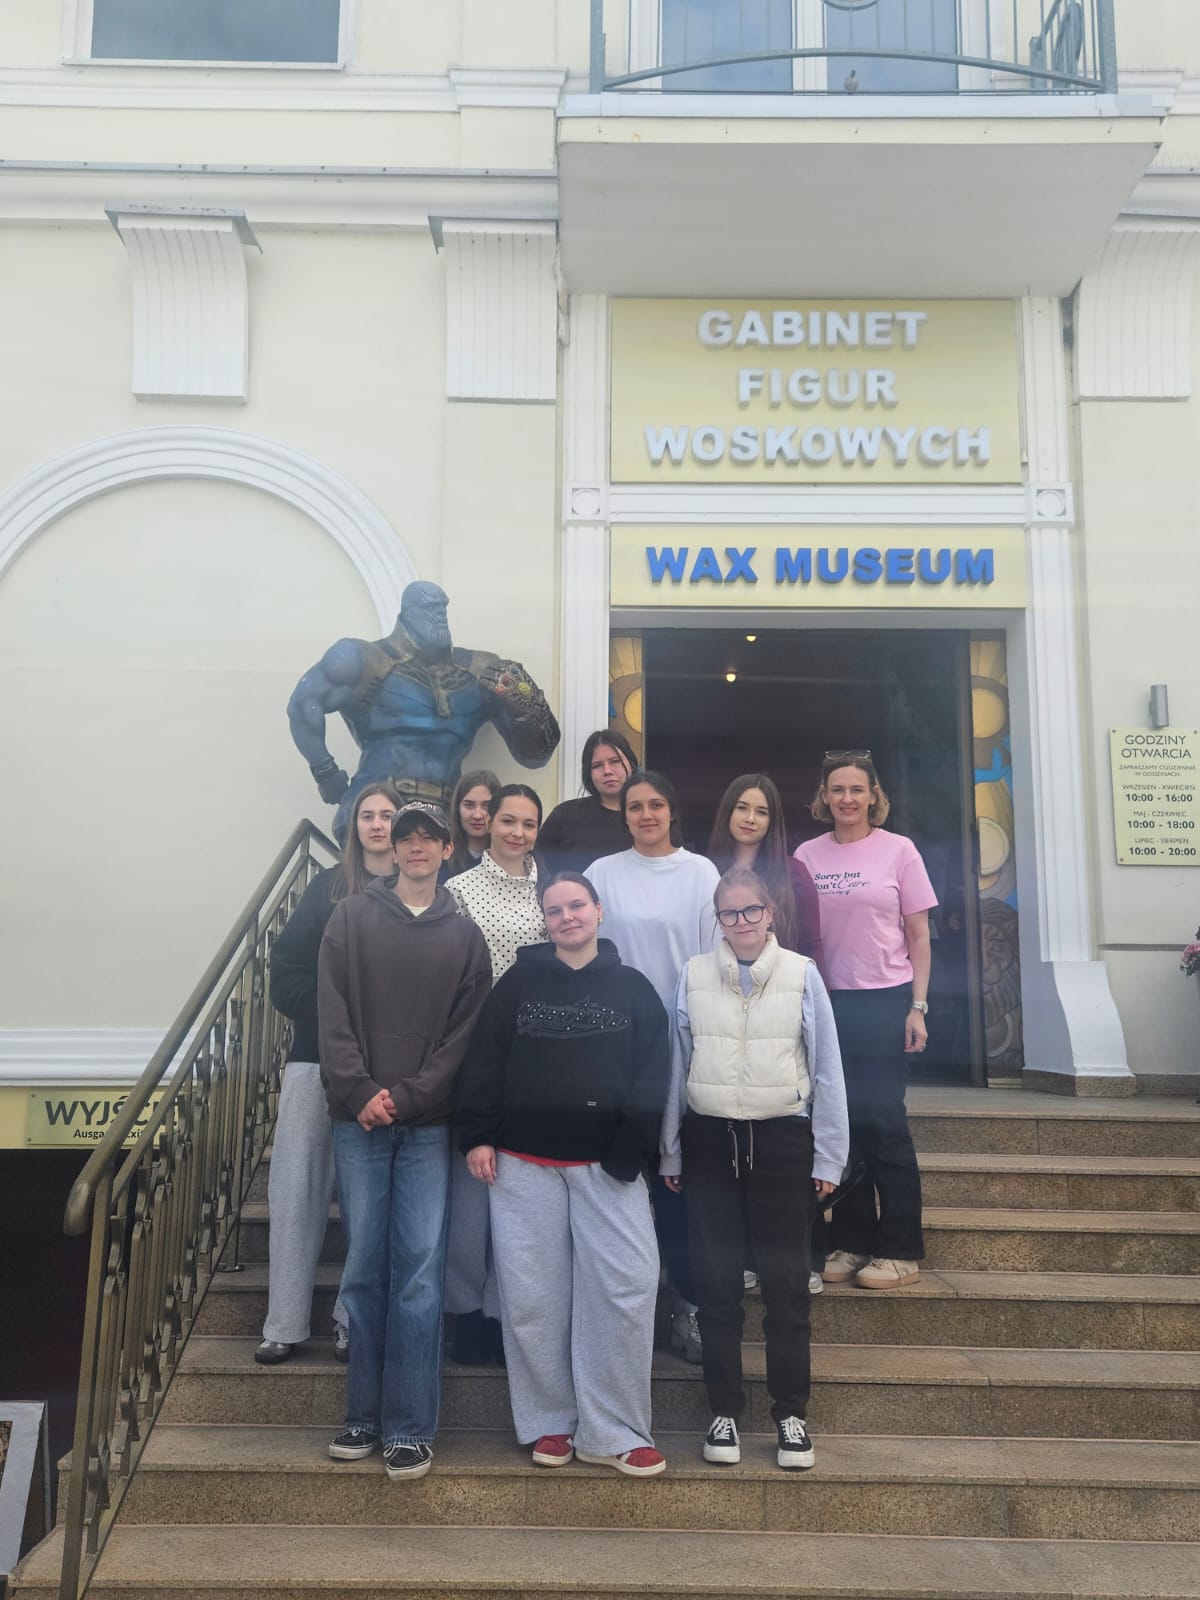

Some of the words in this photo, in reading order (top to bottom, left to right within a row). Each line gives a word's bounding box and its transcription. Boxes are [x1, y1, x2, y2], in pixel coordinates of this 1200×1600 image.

[697, 310, 928, 348] GABINET
[738, 368, 898, 406] FIGUR
[644, 425, 991, 465] WOSKOWYCH
[646, 546, 758, 583] WAX
[775, 547, 994, 584] MUSEUM
[1124, 734, 1186, 745] GODZINY
[1121, 748, 1192, 759] OTWARCIA
[1125, 793, 1154, 802] 10:00
[1165, 794, 1193, 802] 16:00
[1127, 820, 1155, 829] 10:00
[1167, 820, 1195, 829] 18:00
[1129, 847, 1157, 856] 10:00
[1168, 847, 1197, 856] 20:00
[814, 872, 842, 881] Sorry
[844, 871, 861, 879] but
